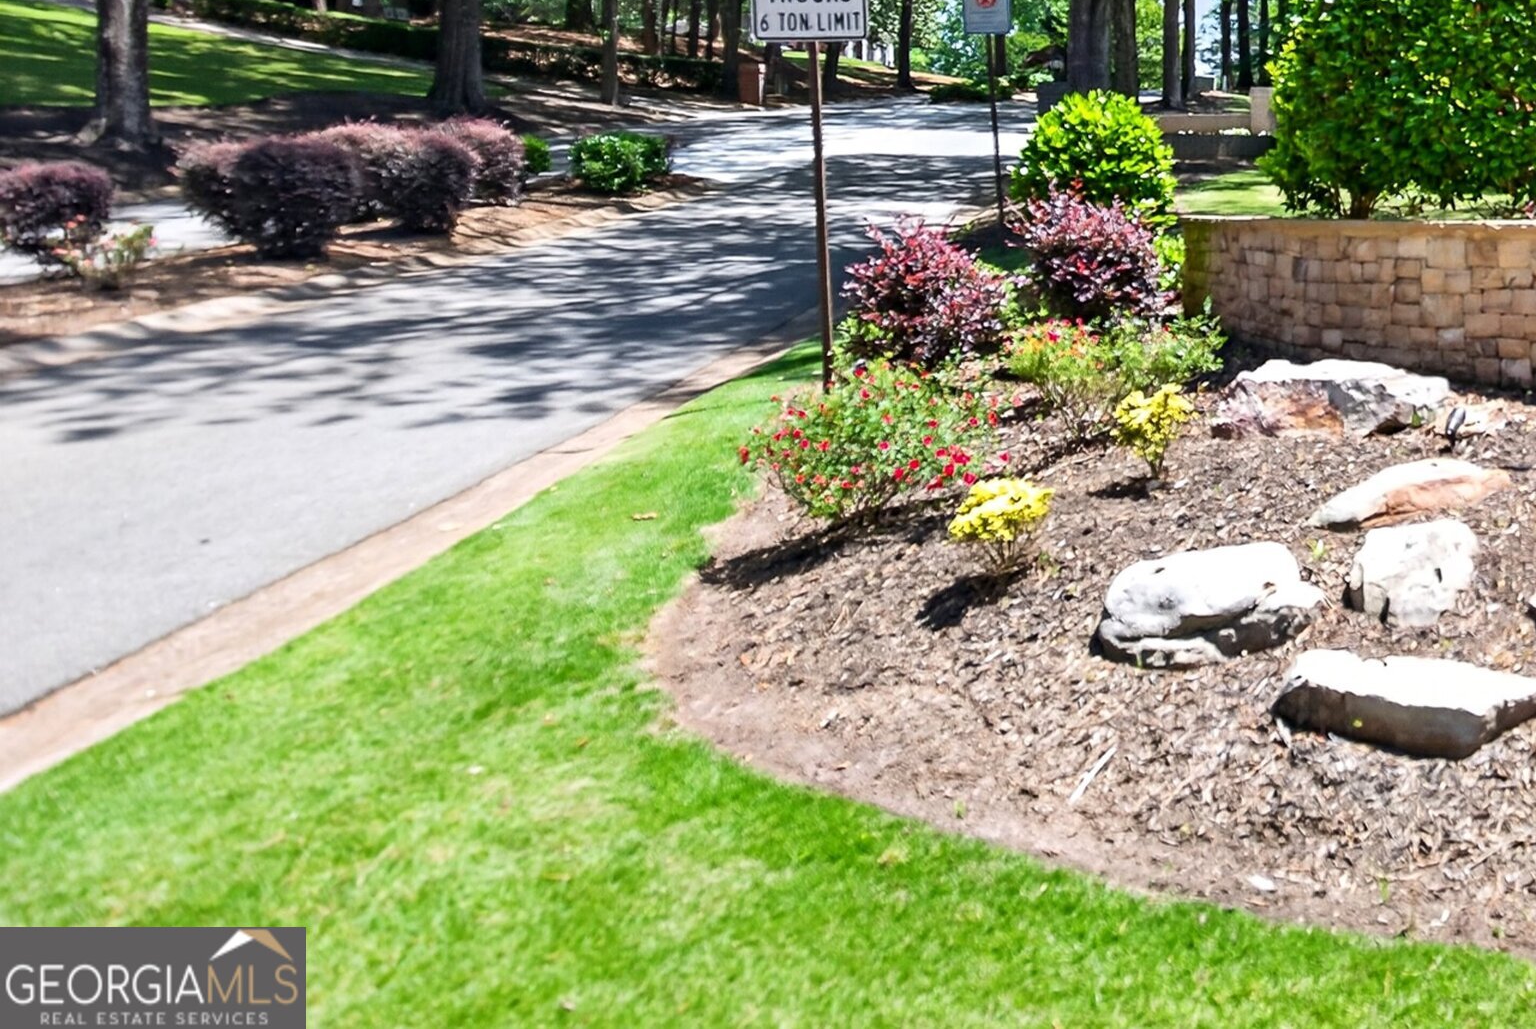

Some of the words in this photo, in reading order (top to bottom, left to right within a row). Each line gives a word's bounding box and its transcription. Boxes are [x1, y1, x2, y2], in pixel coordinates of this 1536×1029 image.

[760, 13, 769, 32] 6
[778, 12, 809, 31] TON
[817, 12, 860, 31] LIMIT
